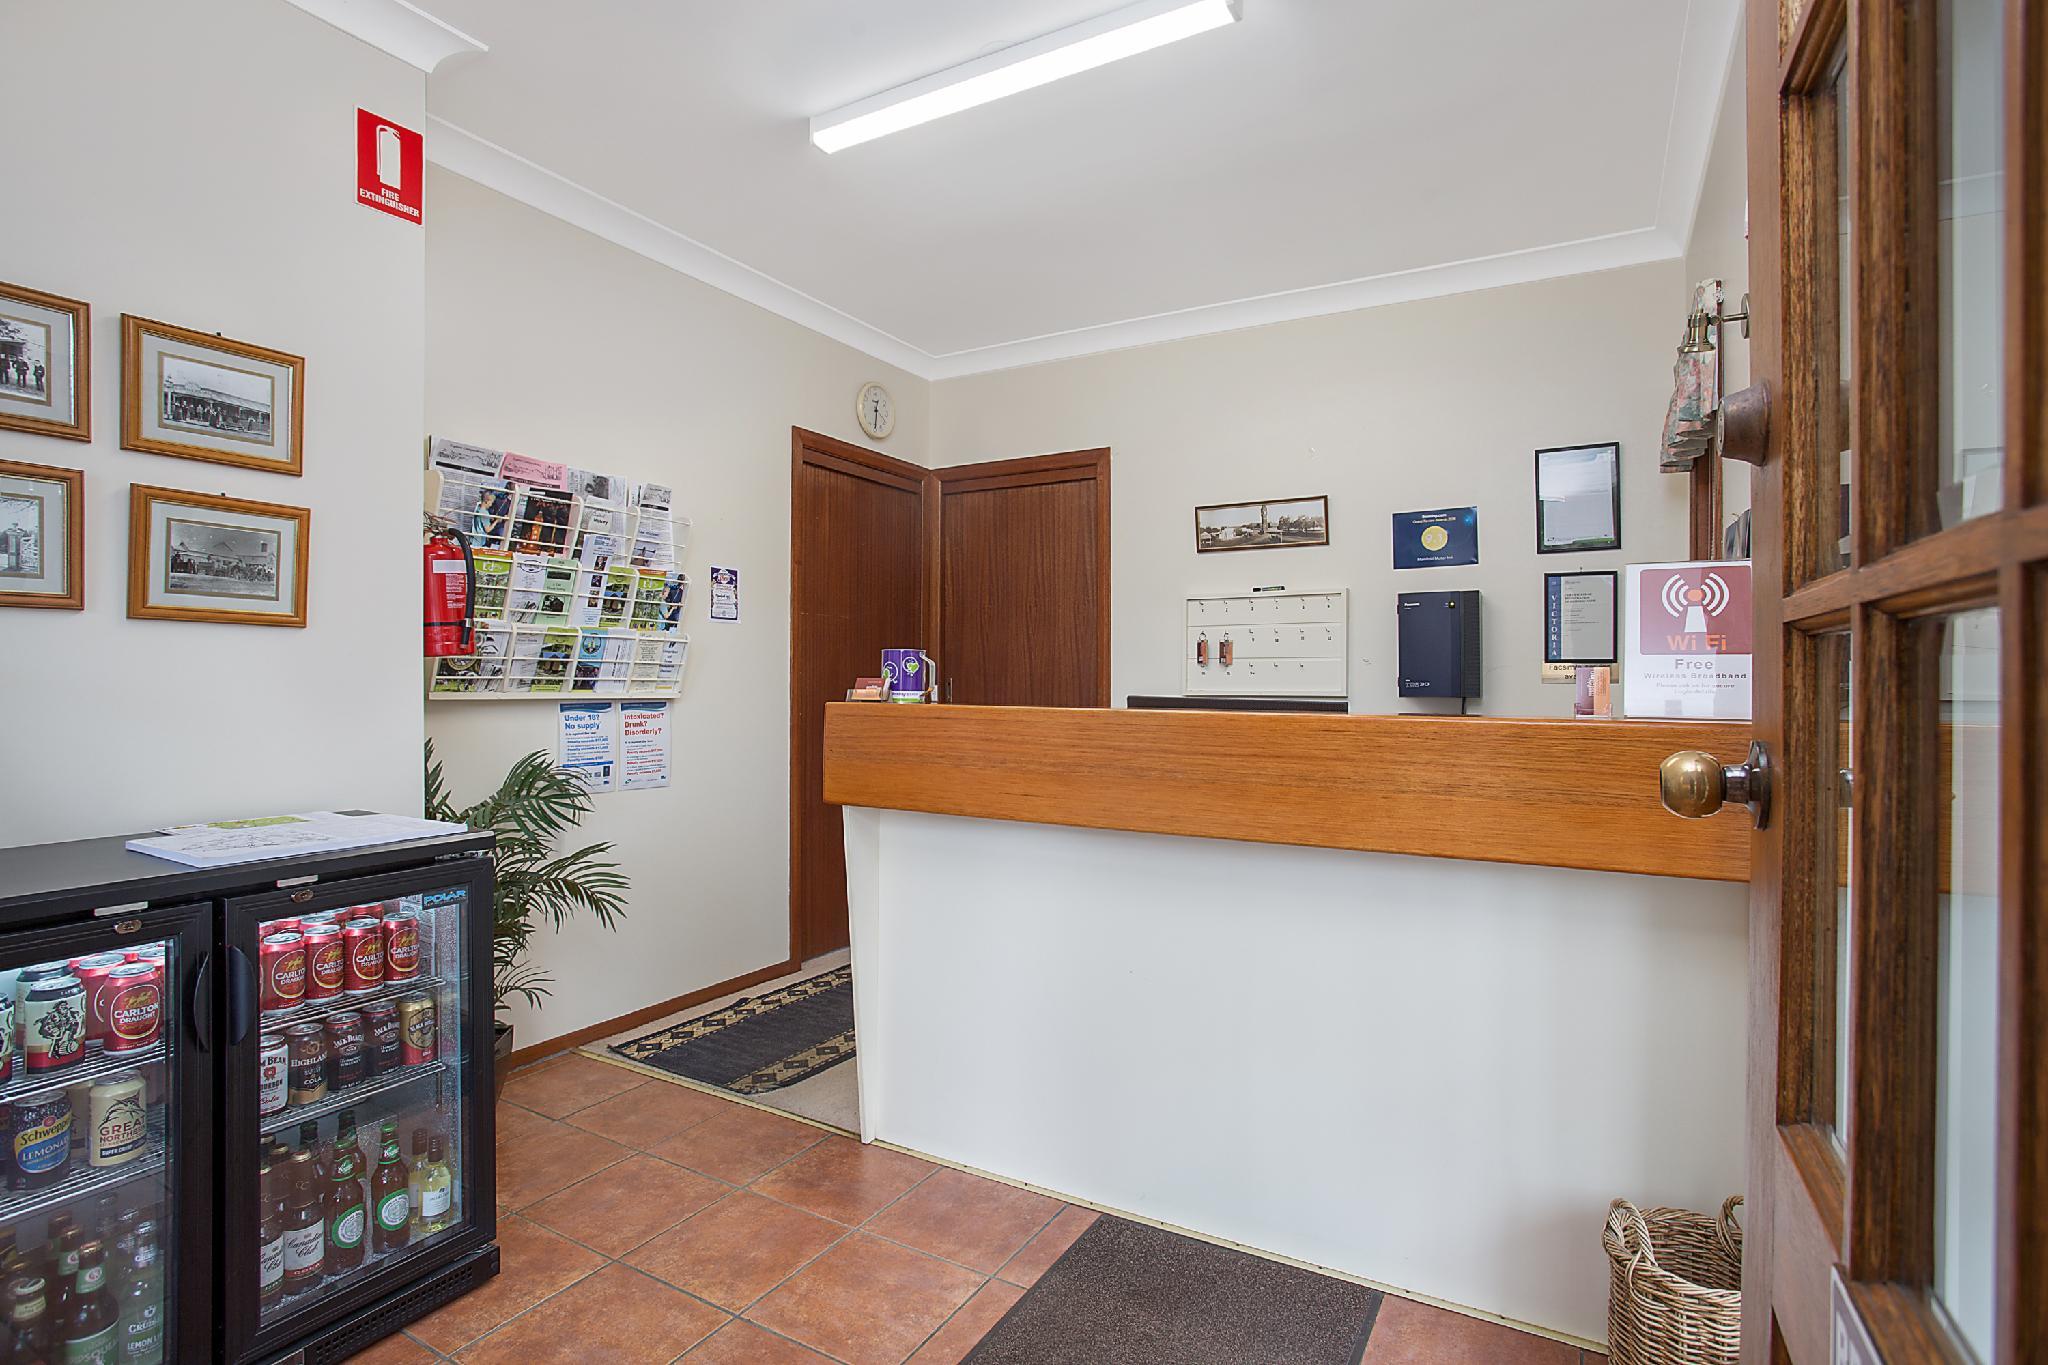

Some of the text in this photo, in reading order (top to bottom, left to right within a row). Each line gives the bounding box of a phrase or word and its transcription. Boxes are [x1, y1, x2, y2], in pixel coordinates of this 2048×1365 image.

[381, 187, 399, 202] FIRE
[359, 187, 420, 218] EXTINGUISHER
[1666, 634, 1727, 651] Wi Fi
[1674, 658, 1714, 670] Free
[624, 713, 665, 721] Intoxicated?
[564, 722, 600, 731] No supply
[624, 721, 648, 729] Drunk?
[624, 728, 662, 737] Disorderly?
[423, 890, 466, 905] POLAR
[114, 1002, 159, 1018] CARLTON
[119, 1011, 156, 1024] DRAUGHT
